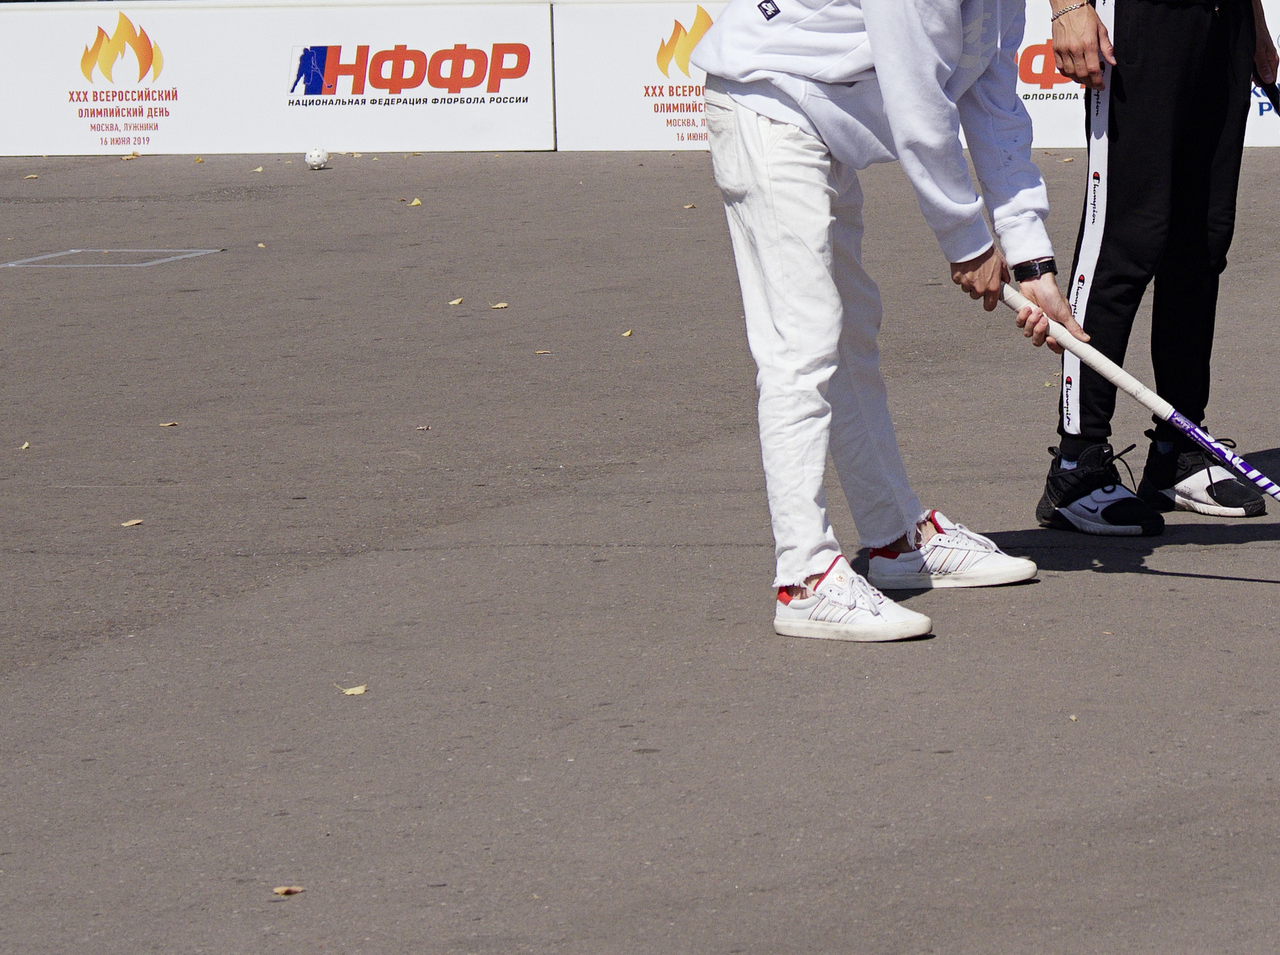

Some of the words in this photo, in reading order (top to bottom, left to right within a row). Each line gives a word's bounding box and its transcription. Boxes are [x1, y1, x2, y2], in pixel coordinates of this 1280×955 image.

[321, 43, 531, 95] НФФР
[92, 87, 178, 102] ВСЕРОССИЙСКИЙ
[1022, 93, 1079, 101] ФЛОРБОЛА
[288, 98, 367, 108] НАЦИОНАЛЬНАЯ
[369, 97, 428, 107] ФЕДЕРАЦИЯ
[431, 96, 486, 106] ФЛОРБОЛА
[489, 96, 529, 104] РОССИИ
[78, 106, 144, 119] ОЛИМПИЙСКИЙ
[147, 107, 170, 119] ДЕНЬ
[90, 123, 121, 133] МОСКВА,
[123, 122, 159, 132] ЛУЖНИКИ
[666, 118, 699, 128] МОСКВА,
[100, 137, 108, 146] 16
[110, 136, 130, 146] ИЮНЯ
[133, 136, 150, 145] 2019
[676, 132, 685, 142] 16
[687, 132, 708, 142] ИЮНЯ
